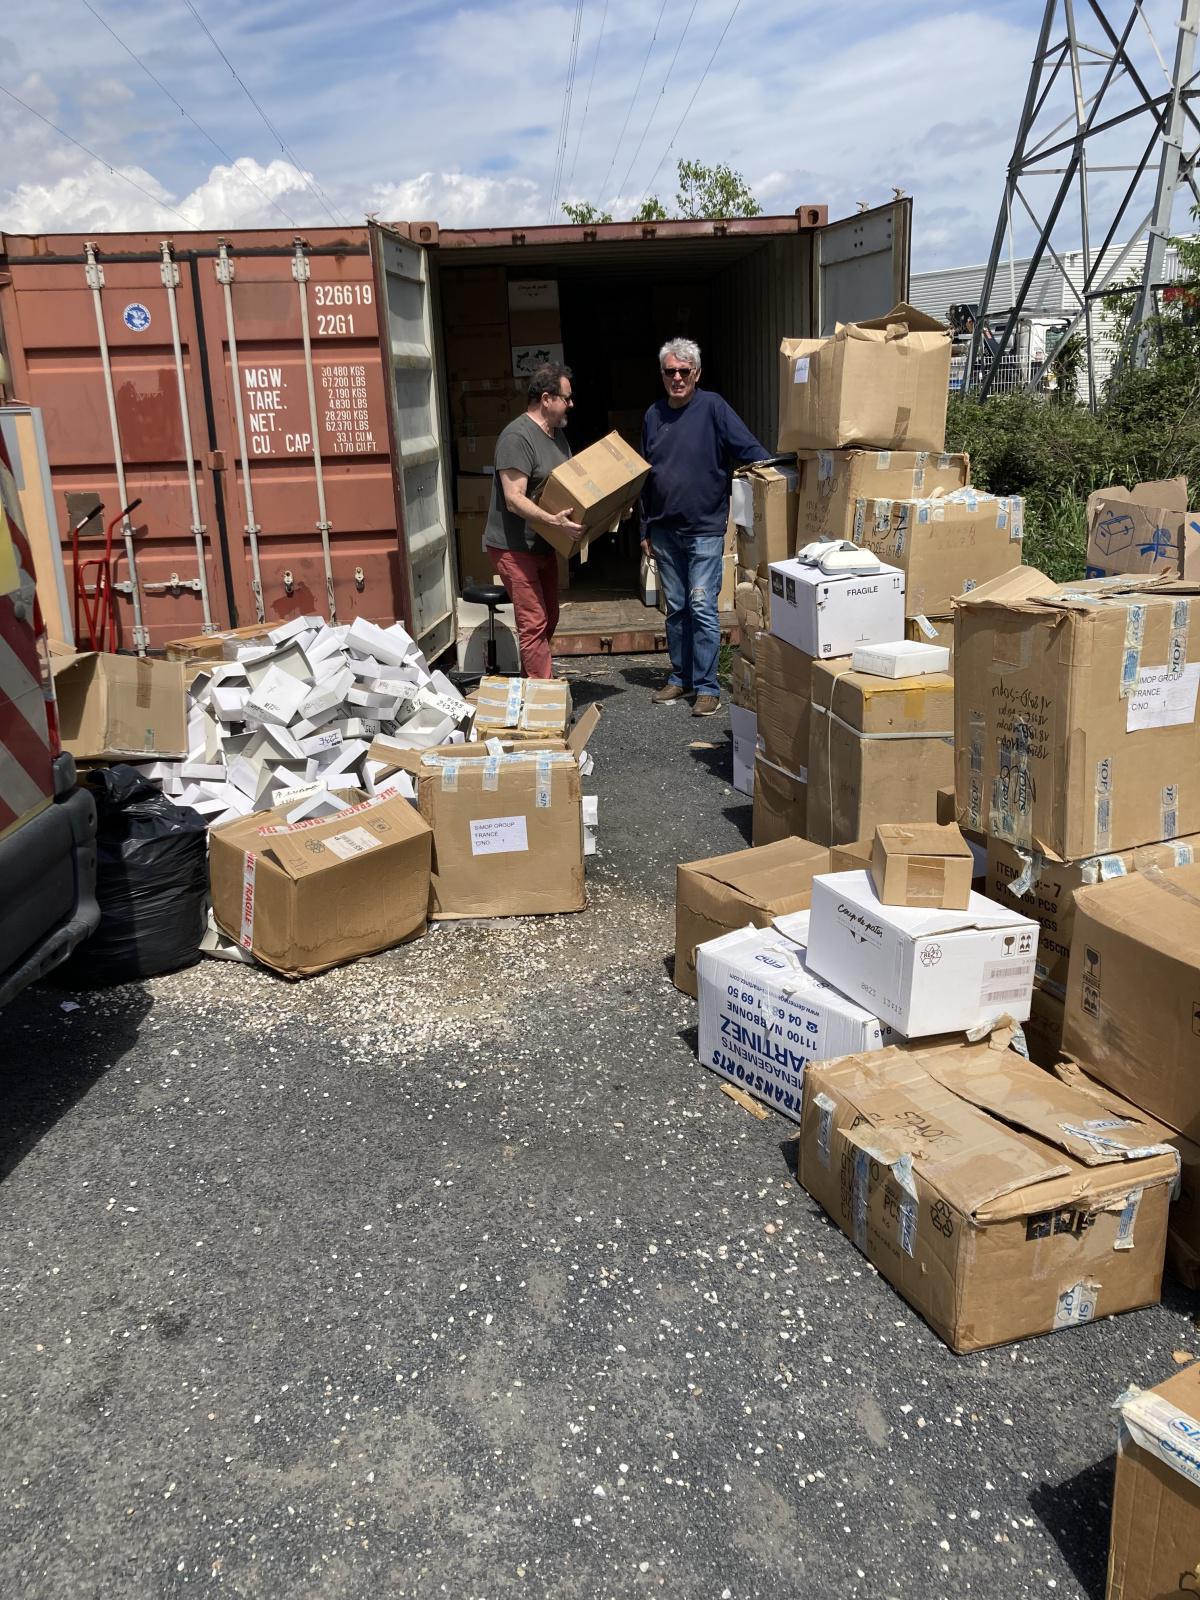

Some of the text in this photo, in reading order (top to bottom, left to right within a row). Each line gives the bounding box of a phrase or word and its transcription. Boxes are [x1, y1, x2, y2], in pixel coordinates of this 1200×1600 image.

[315, 284, 372, 306] 326619
[317, 314, 355, 335] 22G1
[244, 367, 288, 389] MGW.
[321, 366, 365, 377] 30.480 KGS
[322, 376, 366, 388] 67.200 LBS
[328, 388, 367, 399] 2.190 KGS
[247, 390, 288, 411] TARE.
[329, 399, 368, 410] 4.830 LBS
[325, 410, 369, 421] 28.290 KGS
[249, 412, 282, 433] NET.
[326, 421, 369, 432] 62.370 LBS
[252, 432, 315, 455] CU. CAP.
[336, 432, 353, 443] 33.1
[333, 443, 354, 453] 1.170
[846, 585, 879, 597] FRAGILE
[493, 821, 516, 829] GROUP
[995, 861, 1019, 878] ITEM
[245, 882, 255, 924] FRAGILE
[1038, 897, 1058, 914] PCS
[727, 985, 739, 998] 50
[741, 992, 754, 1005] 69
[789, 1014, 802, 1027] 04
[873, 1026, 892, 1038] BAS
[720, 1014, 808, 1073] ARTINEZ
[787, 1030, 818, 1051] 11100
[712, 1050, 801, 1114] TRANSPORTS
